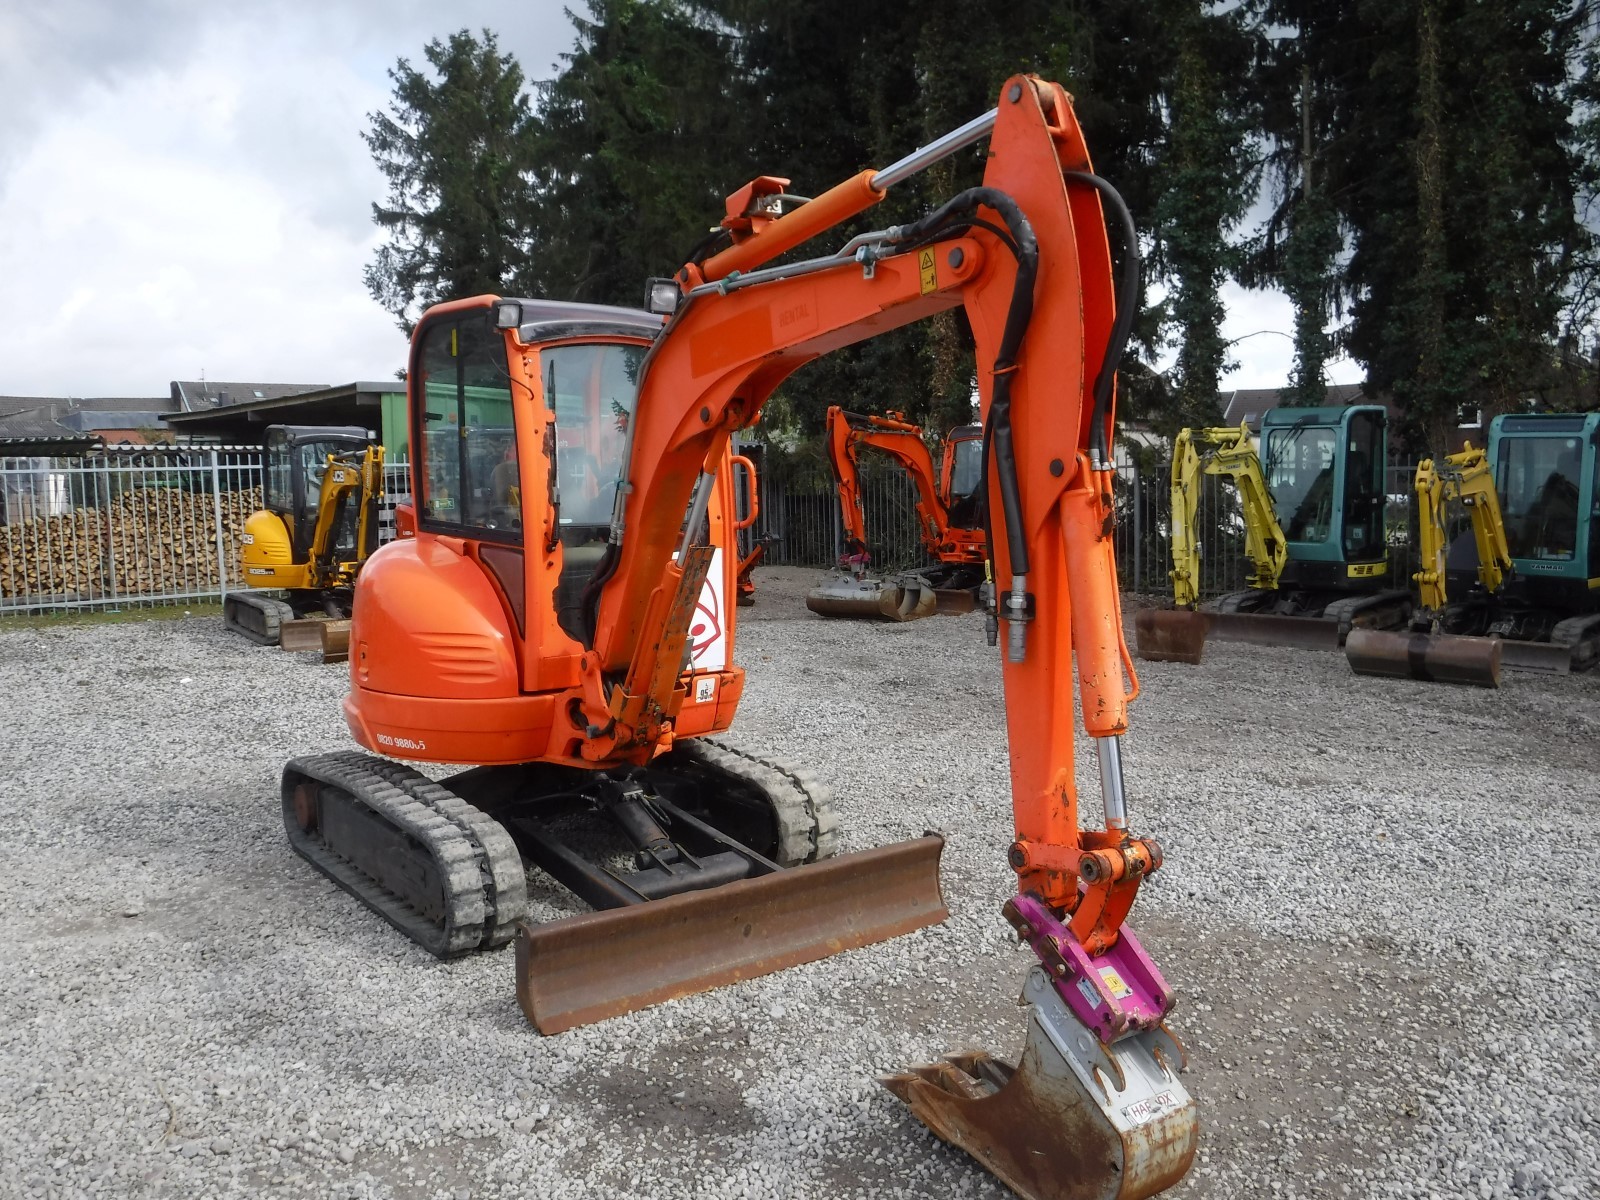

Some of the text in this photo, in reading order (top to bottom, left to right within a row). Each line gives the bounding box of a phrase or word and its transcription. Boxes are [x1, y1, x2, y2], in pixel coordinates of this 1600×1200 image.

[779, 303, 810, 328] RENTAL
[333, 470, 345, 482] JCB
[242, 533, 254, 545] CB
[376, 733, 393, 746] 0820
[1130, 1093, 1173, 1119] HAROX
